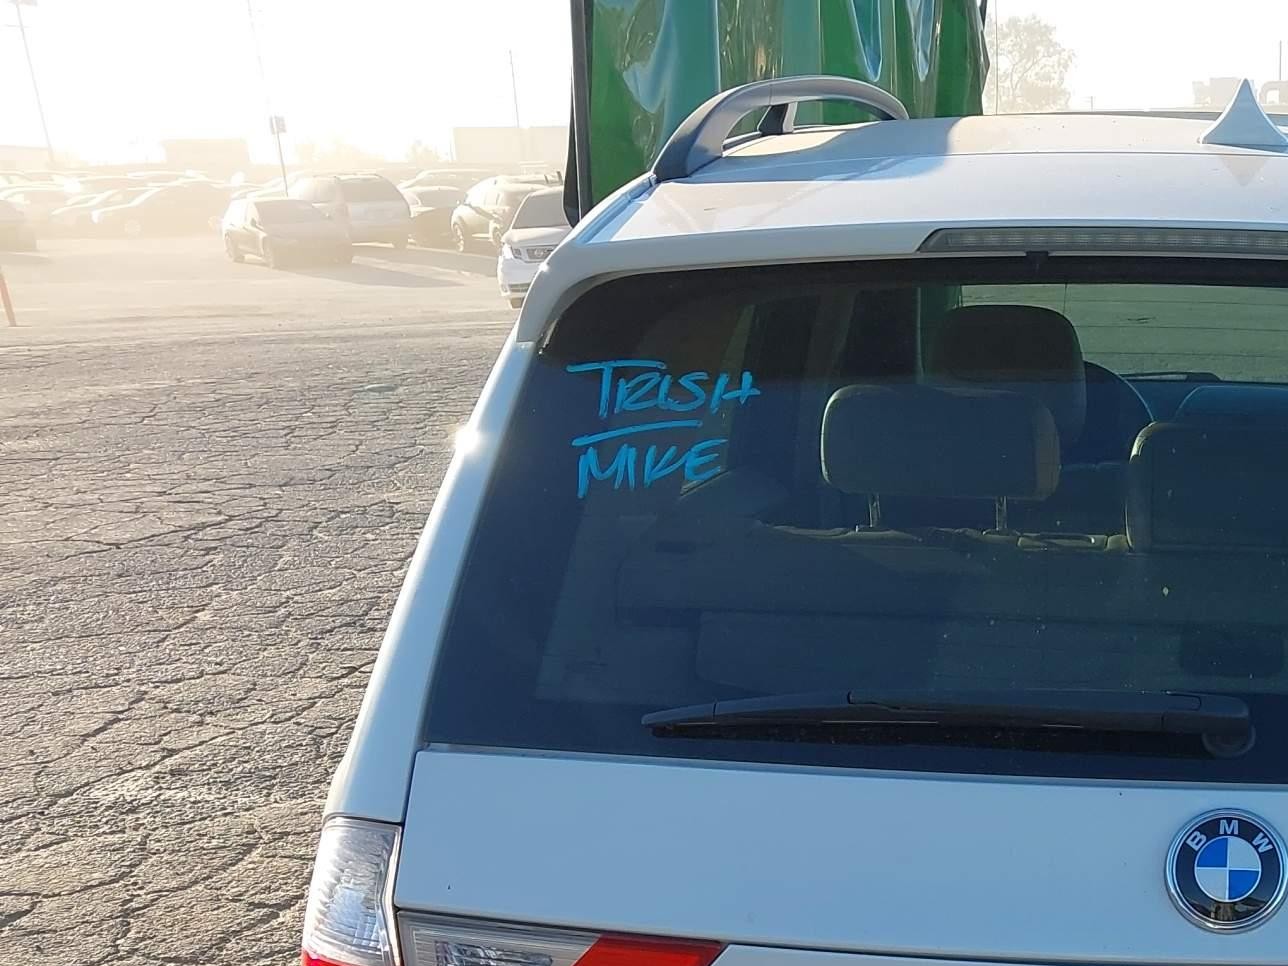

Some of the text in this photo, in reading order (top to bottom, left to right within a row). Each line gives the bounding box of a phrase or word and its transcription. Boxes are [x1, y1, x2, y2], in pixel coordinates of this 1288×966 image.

[566, 359, 761, 418] TRISH
[577, 439, 728, 499] MIKE
[1185, 819, 1274, 854] BMW
